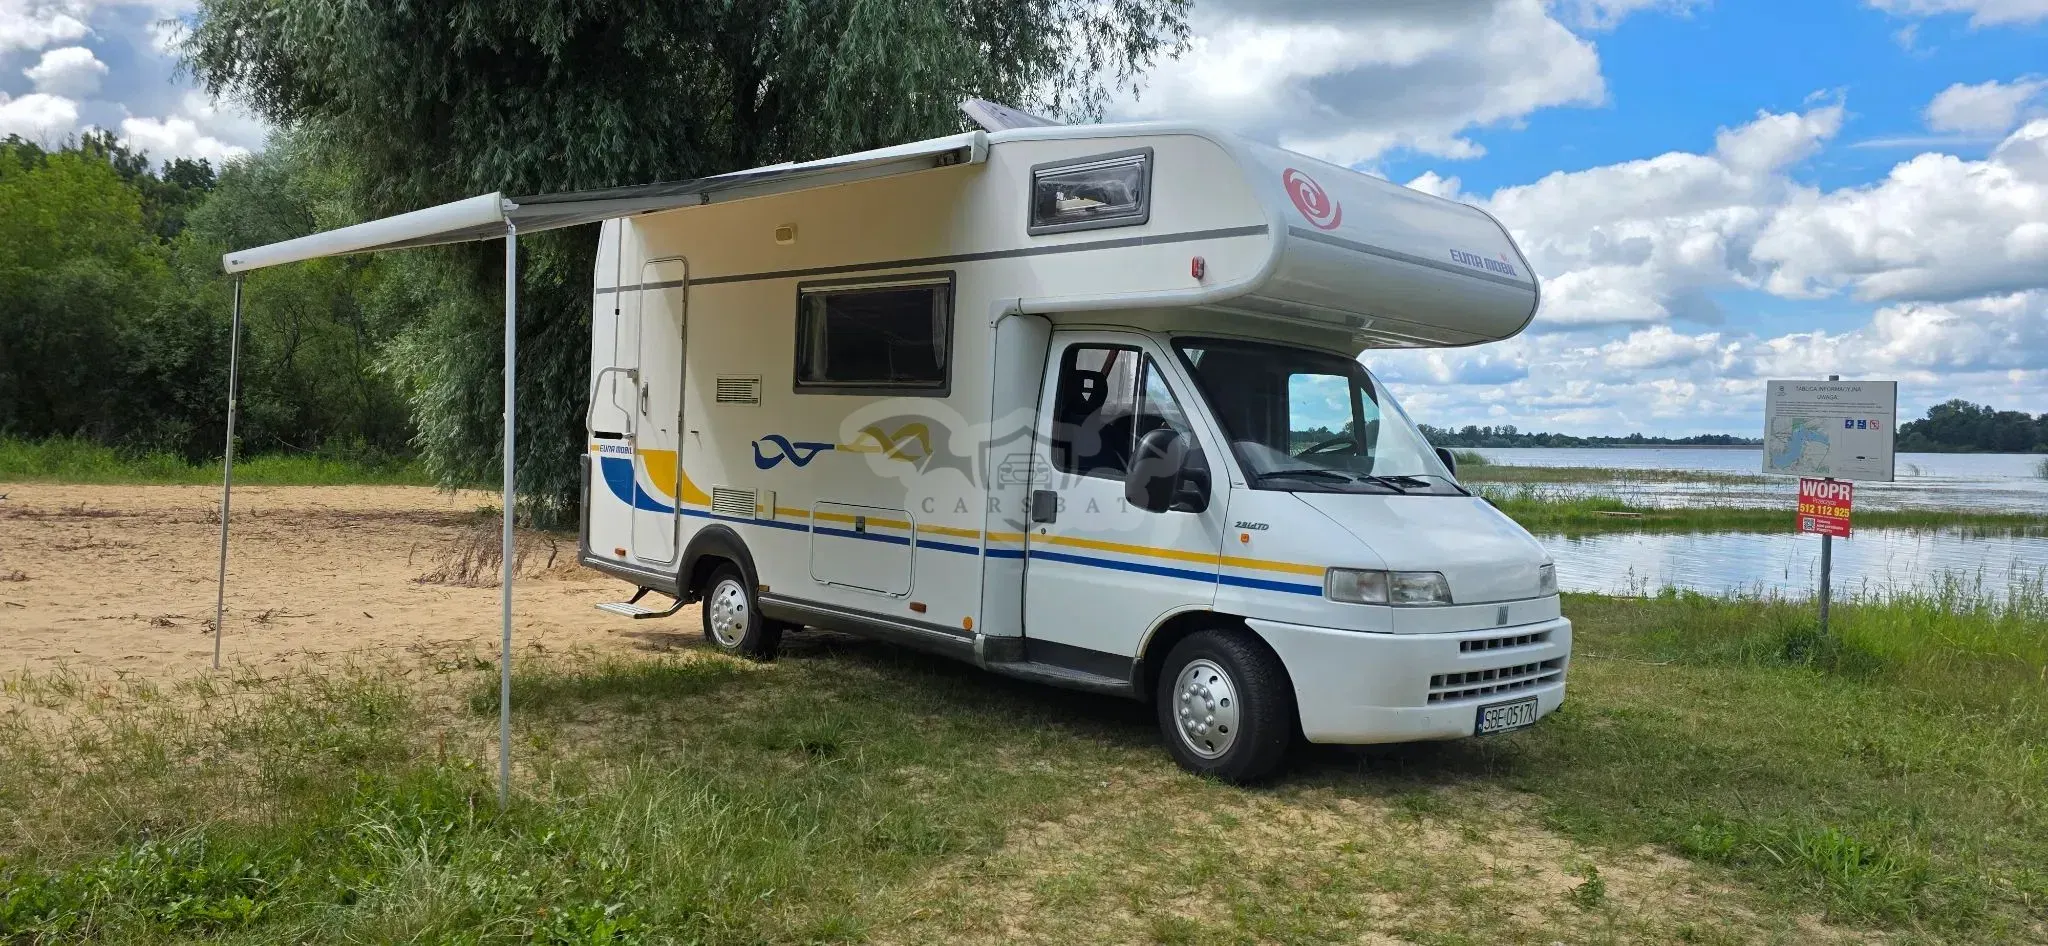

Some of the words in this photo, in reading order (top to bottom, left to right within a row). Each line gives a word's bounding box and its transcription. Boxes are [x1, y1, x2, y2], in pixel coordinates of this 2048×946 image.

[1484, 258, 1517, 276] MOBIL
[1802, 480, 1850, 501] WOPR
[1799, 503, 1815, 514] 512
[1817, 505, 1832, 516] 112
[1834, 507, 1850, 518] 925
[1484, 708, 1505, 730] SBE
[1507, 702, 1536, 726] 0517K
